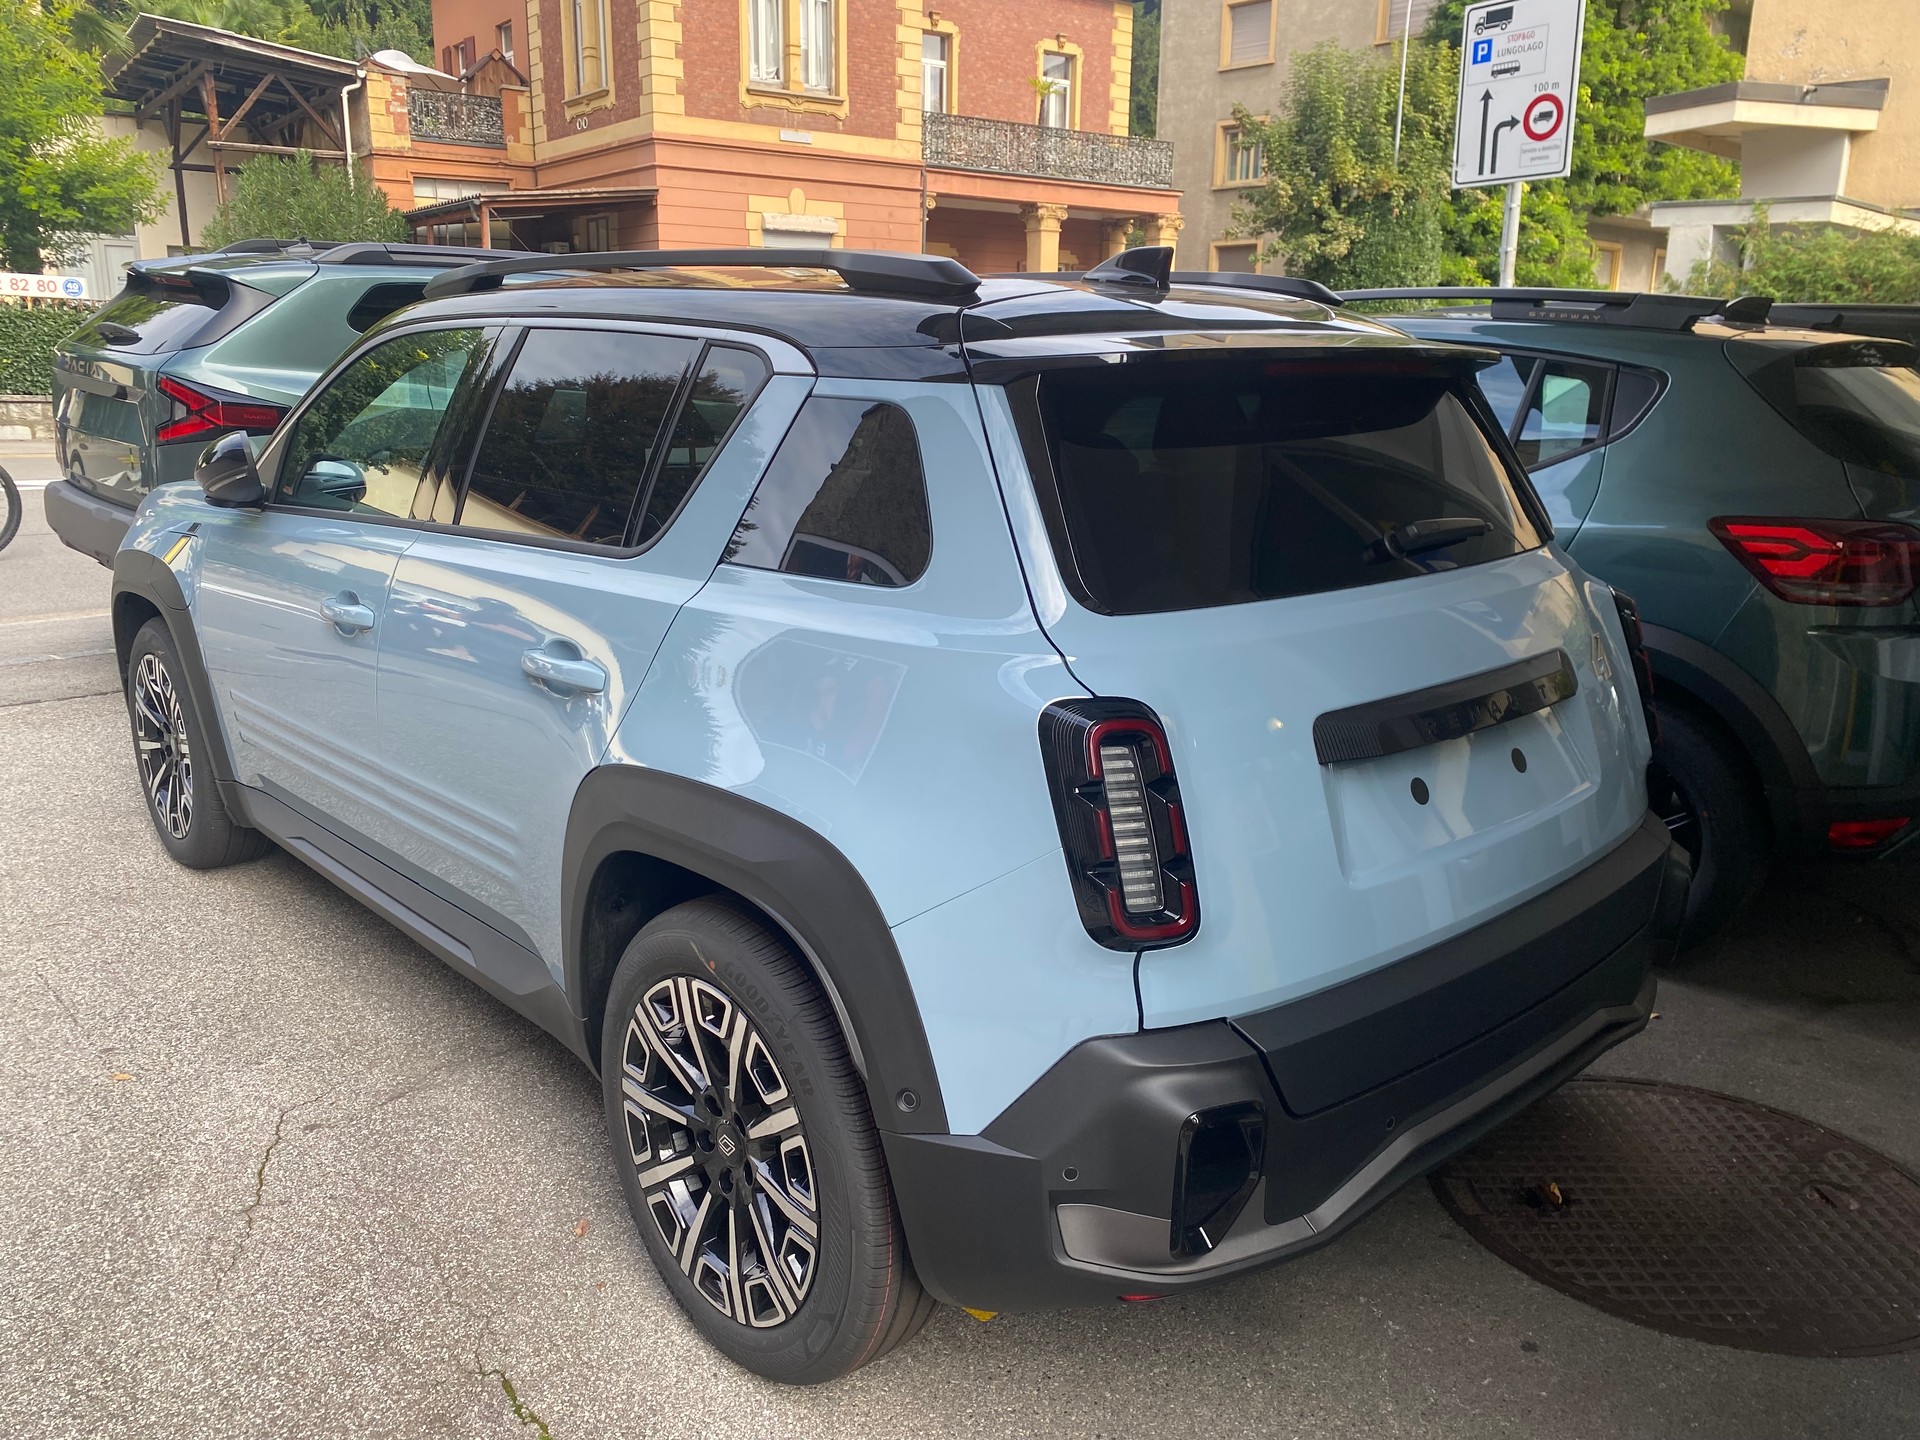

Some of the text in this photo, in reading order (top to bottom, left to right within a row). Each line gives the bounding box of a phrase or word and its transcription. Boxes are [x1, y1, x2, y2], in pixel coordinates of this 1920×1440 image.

[1507, 30, 1536, 43] STOP&GO
[1477, 43, 1488, 62] P
[1497, 41, 1544, 57] LUNGOLAGO
[1534, 82, 1560, 92] 100 m
[10, 278, 29, 291] 82
[37, 279, 57, 293] 80
[1528, 311, 1601, 320] STEPWAY
